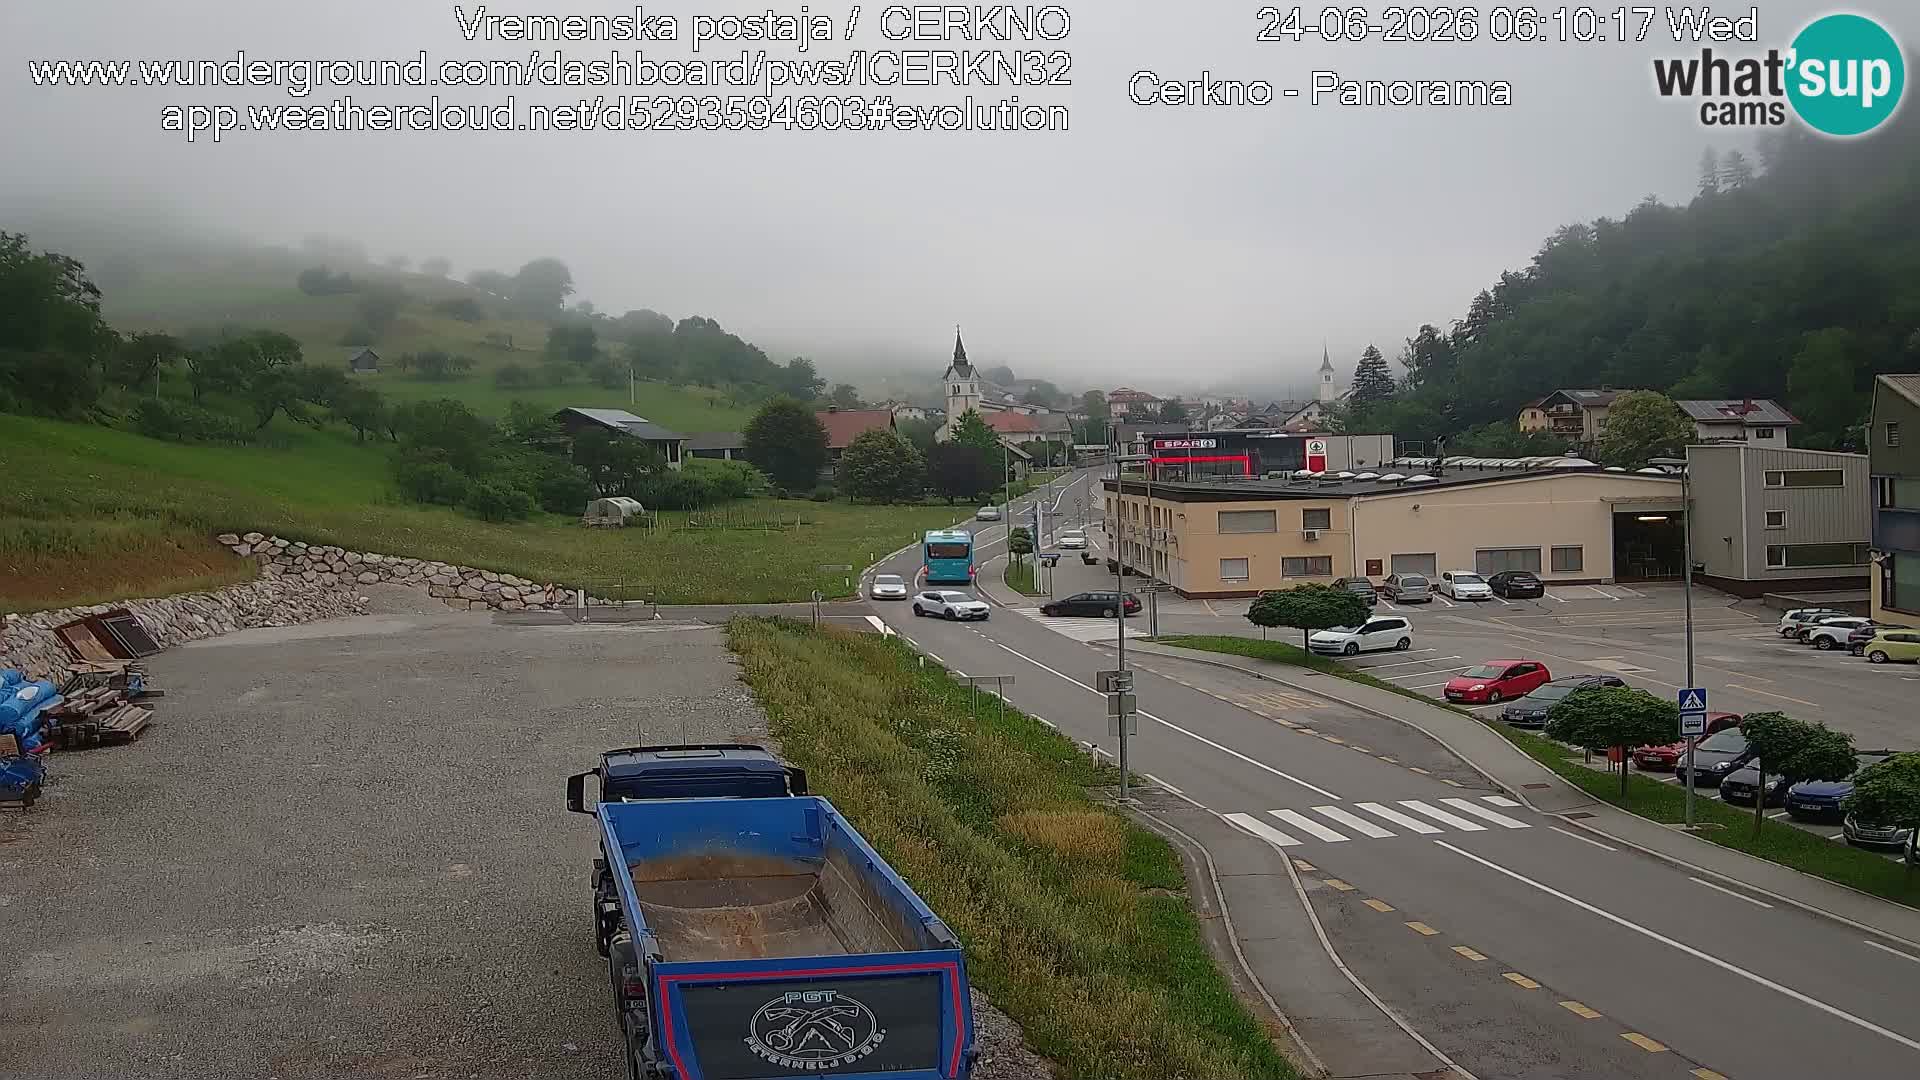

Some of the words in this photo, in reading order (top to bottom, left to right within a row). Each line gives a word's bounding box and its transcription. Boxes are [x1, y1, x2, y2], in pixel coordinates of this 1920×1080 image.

[1164, 440, 1201, 448] SPAR
[785, 991, 837, 1004] PGT
[744, 1036, 840, 1070] PETERNELJ
